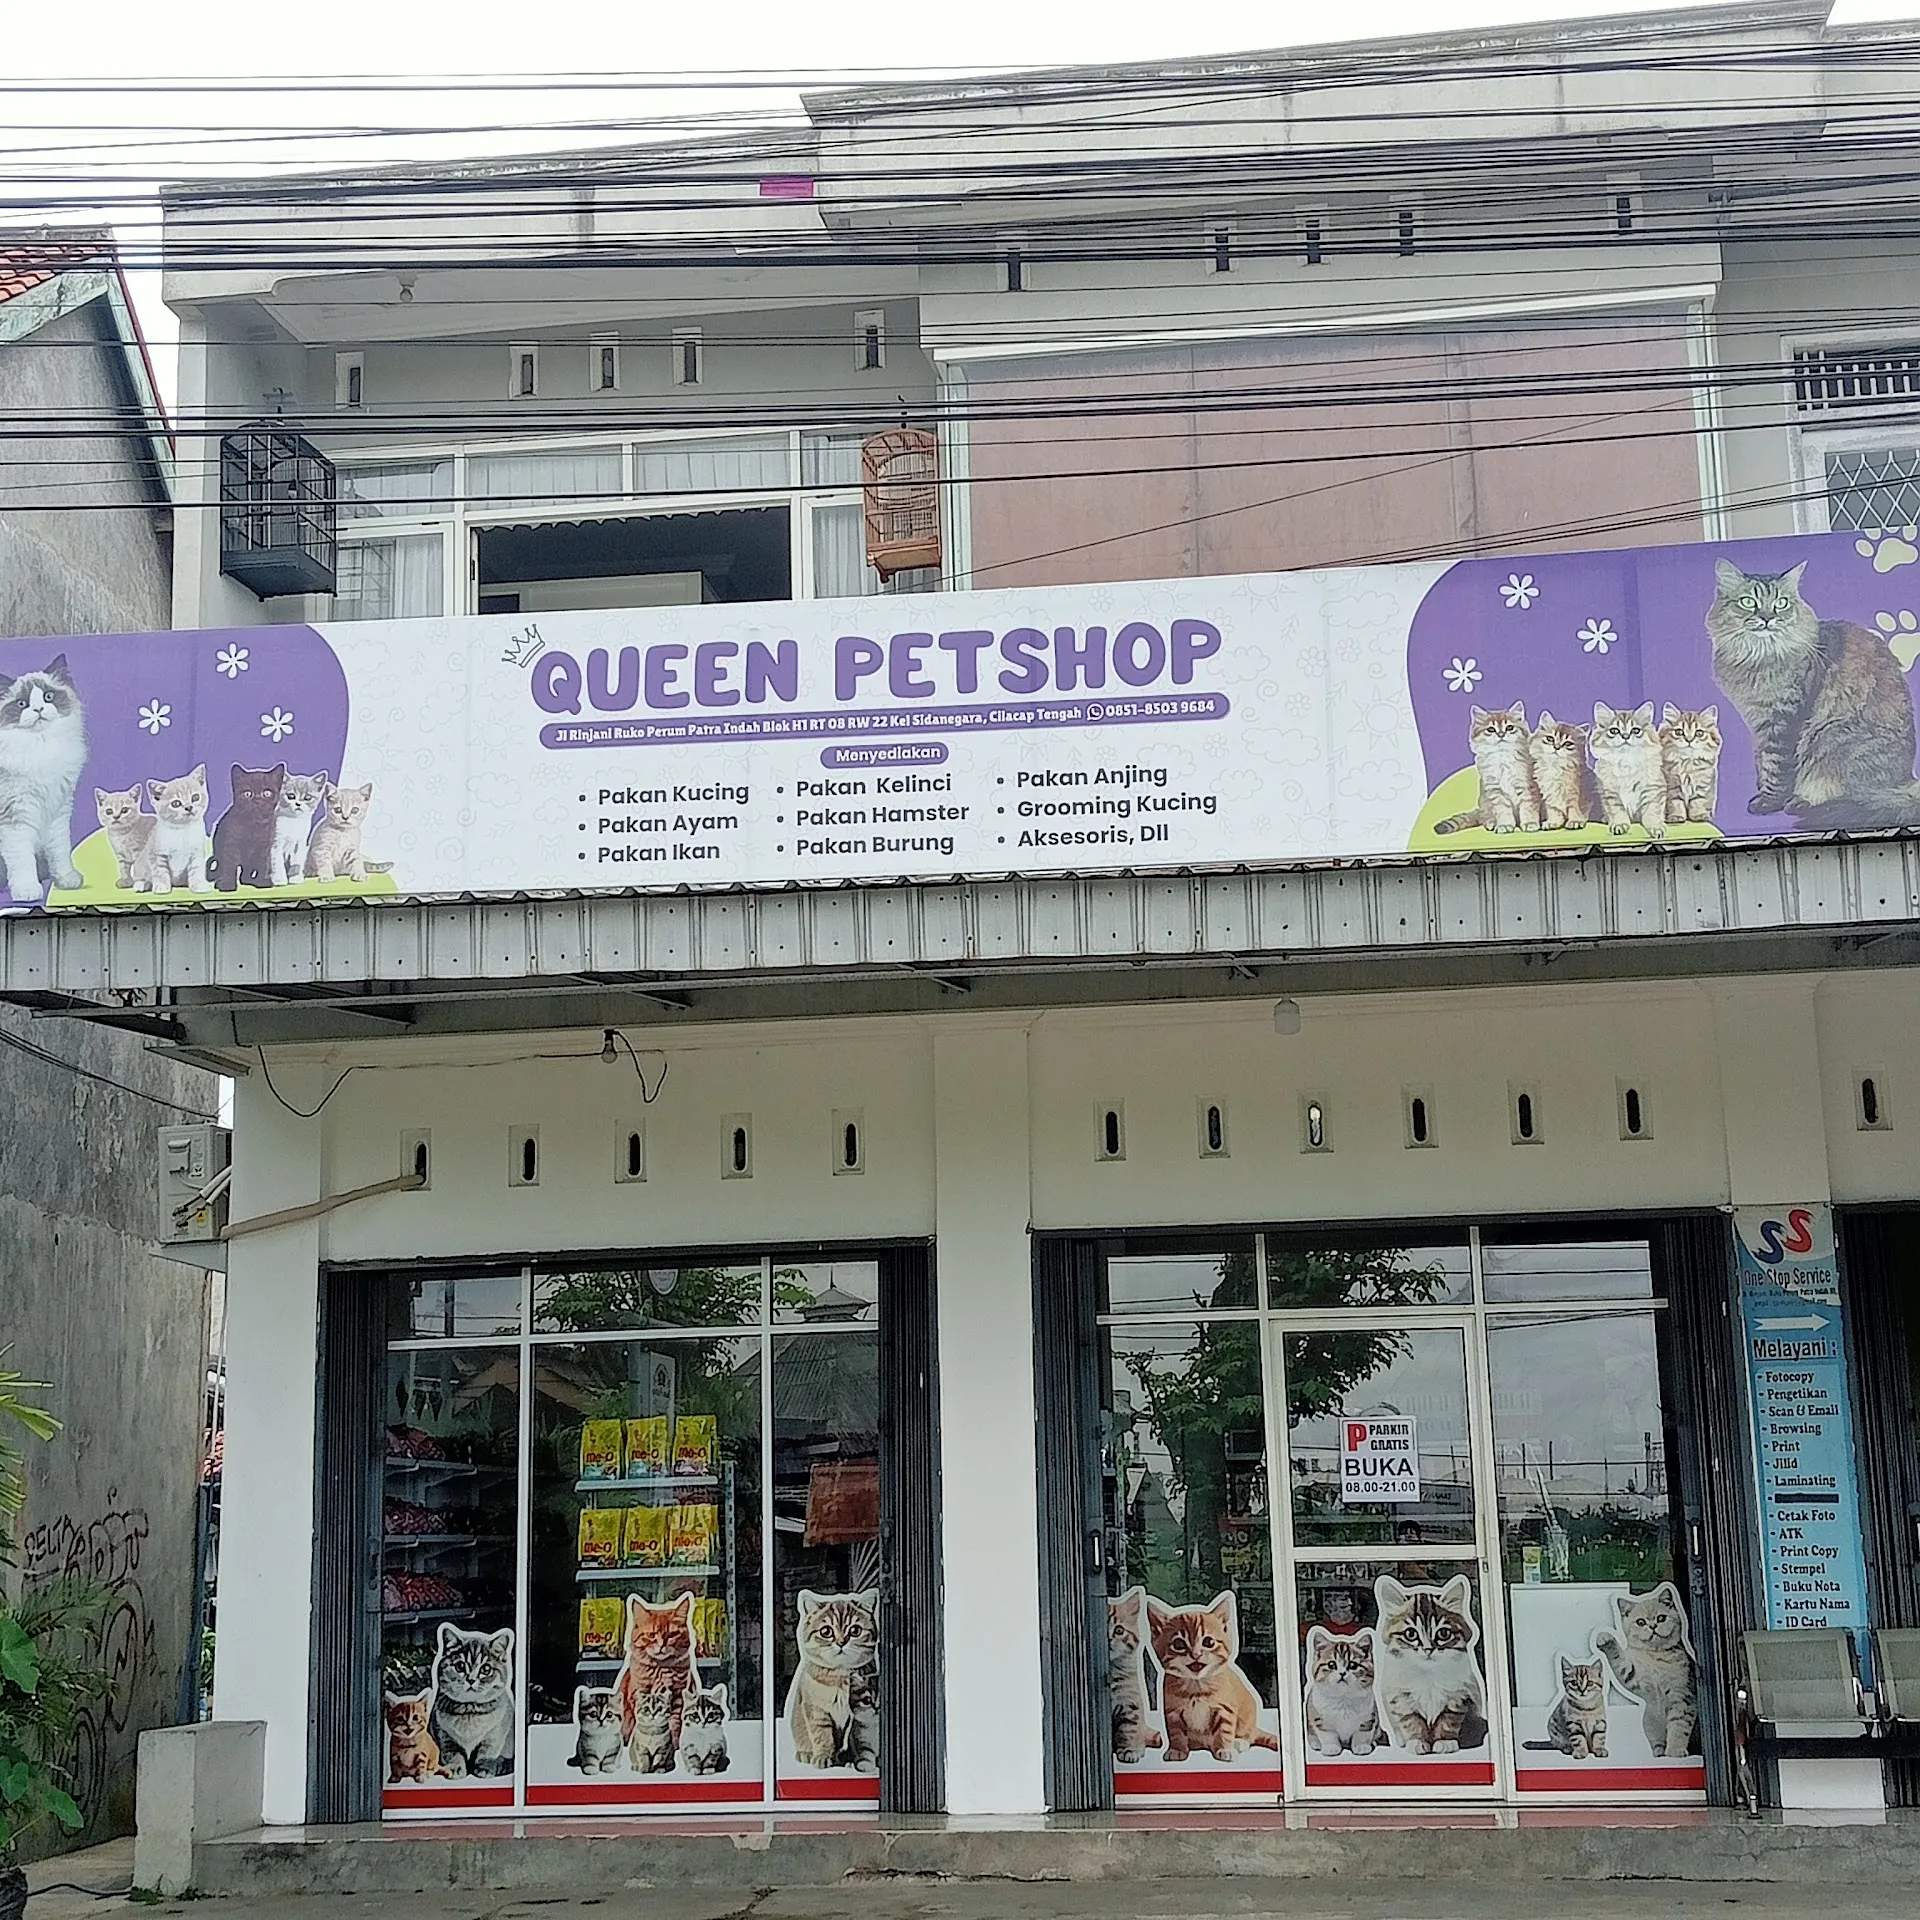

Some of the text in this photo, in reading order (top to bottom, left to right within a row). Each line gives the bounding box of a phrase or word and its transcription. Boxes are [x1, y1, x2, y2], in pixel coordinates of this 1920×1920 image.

[531, 619, 1222, 716] QUEEN PETSHOP
[569, 727, 612, 744] Rinjani
[614, 727, 645, 738] Ruko
[647, 725, 686, 737] Perum
[688, 724, 722, 736] Patra
[723, 722, 760, 734] Indah
[762, 720, 790, 732] Blok
[809, 719, 825, 730] RT
[828, 718, 845, 729] 08
[847, 717, 870, 729] RW
[872, 716, 888, 728] 22
[890, 715, 911, 727] Kel
[912, 712, 988, 727] Sidanegara,
[989, 709, 1034, 724] Cilacap
[1036, 707, 1082, 722] Tengah
[1105, 702, 1178, 717] 0851-8503
[1180, 700, 1215, 713] 9684
[836, 746, 941, 764] Menyediakan
[1017, 765, 1168, 788] Pakan Anjing
[797, 774, 952, 797] Pakan Kelinci
[598, 783, 750, 805] Pakan Kucing
[1017, 793, 1217, 818] Grooming Kucing
[797, 804, 969, 826] Pakan Hamster
[598, 814, 738, 836] Pakan Ayam
[1018, 825, 1169, 848] Aksesoris, Dll
[598, 844, 720, 863] Pakan Ikan
[797, 836, 954, 857] Pakan Burung
[1744, 1266, 1831, 1288] One Stop Service
[1753, 1337, 1826, 1360] Melayani
[1765, 1371, 1814, 1383] Fotocopy
[1767, 1387, 1828, 1402] Pengetikan
[1768, 1406, 1794, 1416] Scan
[1808, 1405, 1839, 1416] Email
[1369, 1424, 1409, 1435] PARKIR
[1770, 1422, 1822, 1436] Browsing
[1347, 1423, 1367, 1452] P
[1370, 1439, 1409, 1451] GRATIS
[1772, 1440, 1801, 1451] Print
[1345, 1457, 1414, 1477] BUKA
[1772, 1457, 1798, 1469] Jilid
[1346, 1481, 1416, 1493] 08.00-21.00
[1774, 1474, 1836, 1487] Laminating
[1777, 1510, 1836, 1521] Cetak Foto
[1779, 1527, 1804, 1539] ATK
[1780, 1545, 1839, 1558] Print Copy
[1781, 1563, 1826, 1576] Stempel
[1783, 1581, 1841, 1592] Buku Nota
[1784, 1598, 1850, 1610] Kartu Nama
[1785, 1615, 1828, 1627] ID Card
